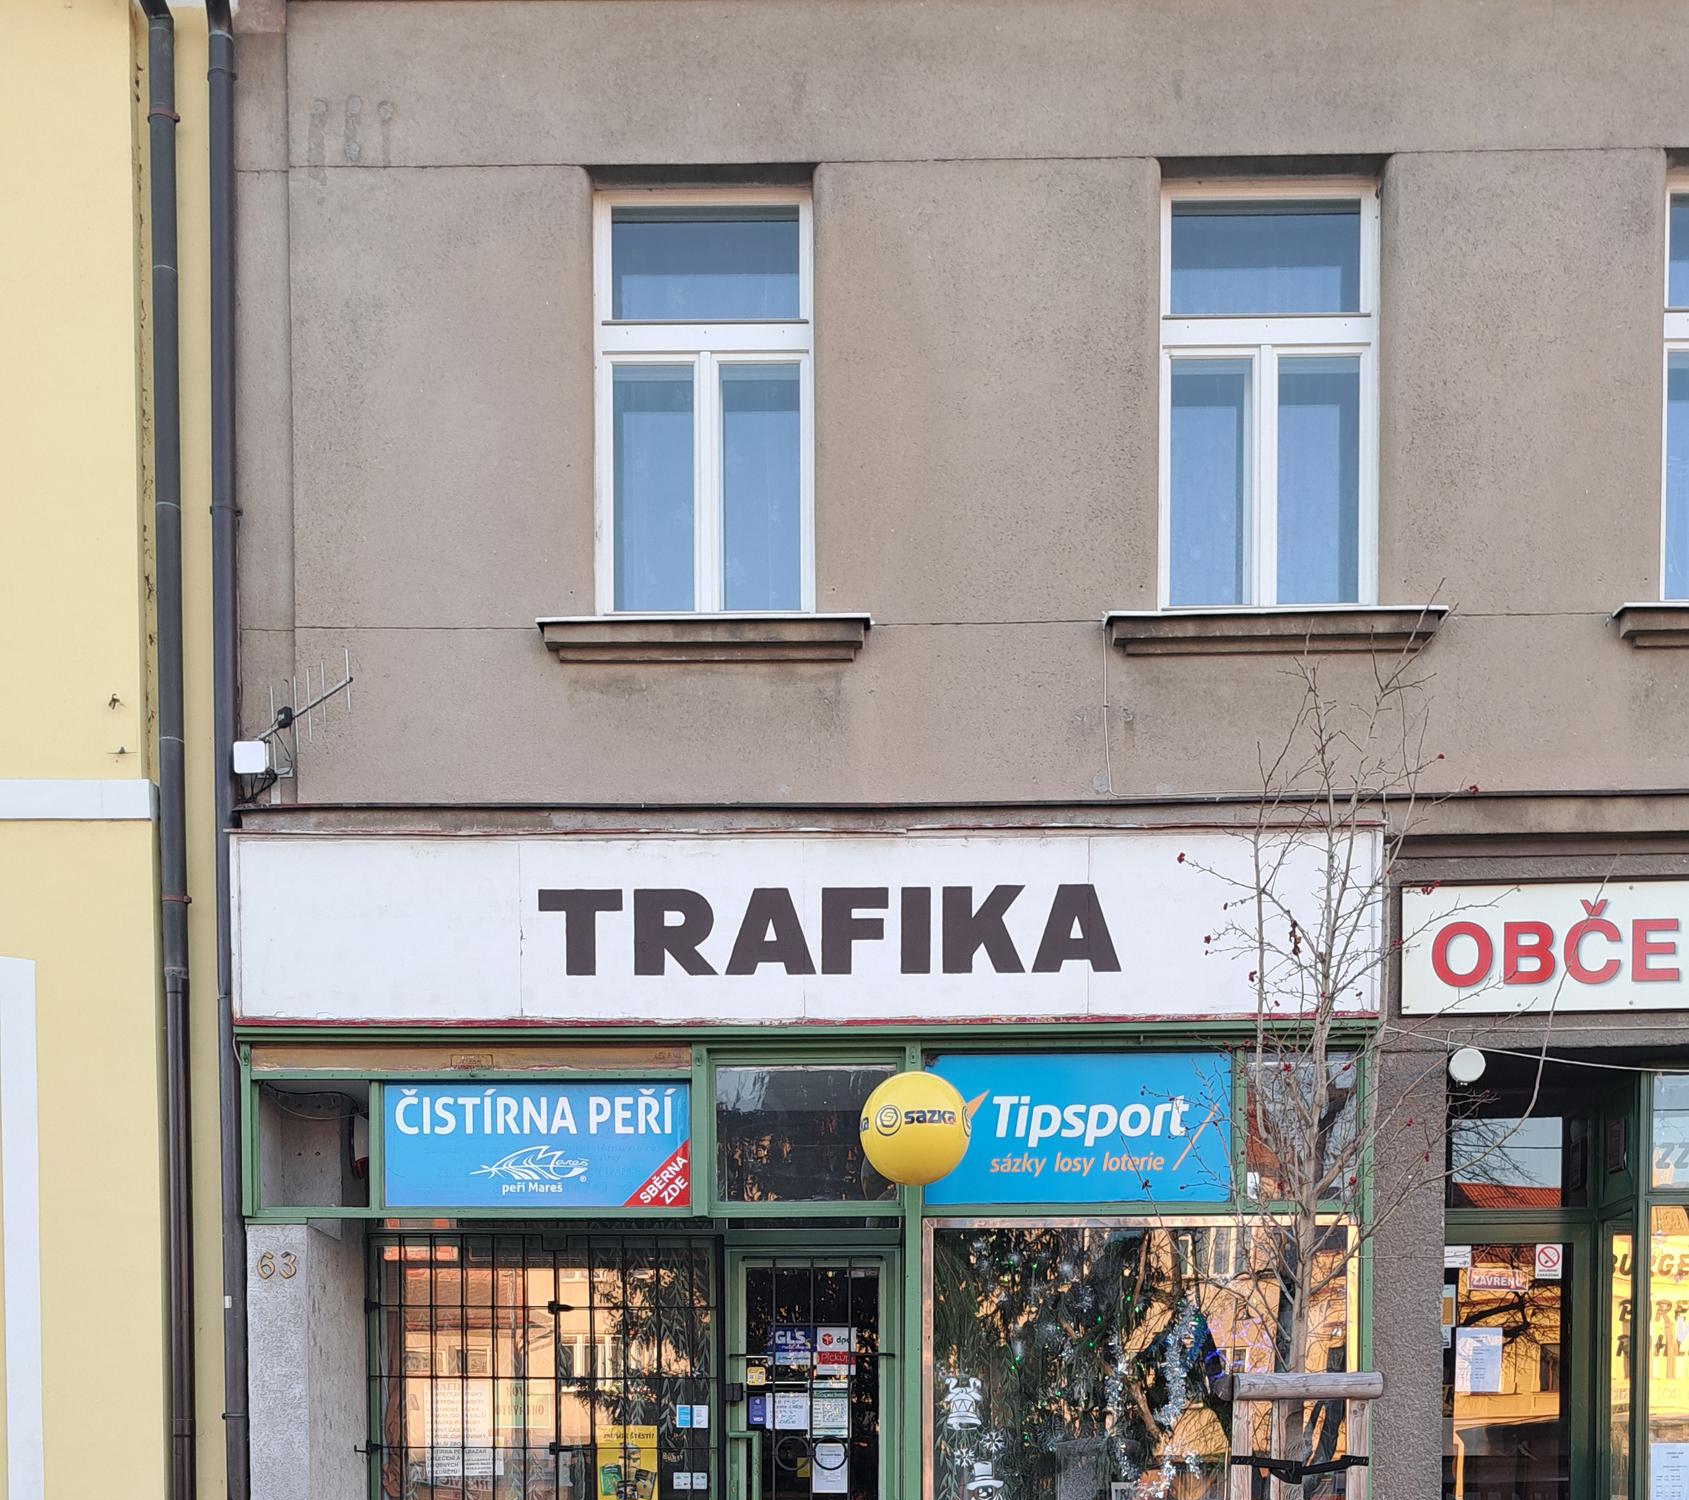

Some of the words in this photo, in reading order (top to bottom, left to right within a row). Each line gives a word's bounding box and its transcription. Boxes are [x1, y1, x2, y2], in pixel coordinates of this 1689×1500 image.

[537, 884, 1121, 976] TRAFIKA
[1431, 898, 1681, 988] OBČE
[395, 1088, 577, 1135] ČISTÍRNA
[589, 1088, 677, 1135] PEŘÍ
[992, 1094, 1190, 1148] Tipsport
[639, 1155, 688, 1204] SBĚRNA
[989, 1153, 1047, 1178] sázky
[1055, 1152, 1095, 1177] losy
[1102, 1153, 1165, 1173] loterie
[502, 1182, 526, 1196] peří
[529, 1181, 563, 1194] Mareš
[660, 1175, 689, 1205] ZDE
[256, 1250, 297, 1280] 63
[775, 1330, 806, 1345] GLS
